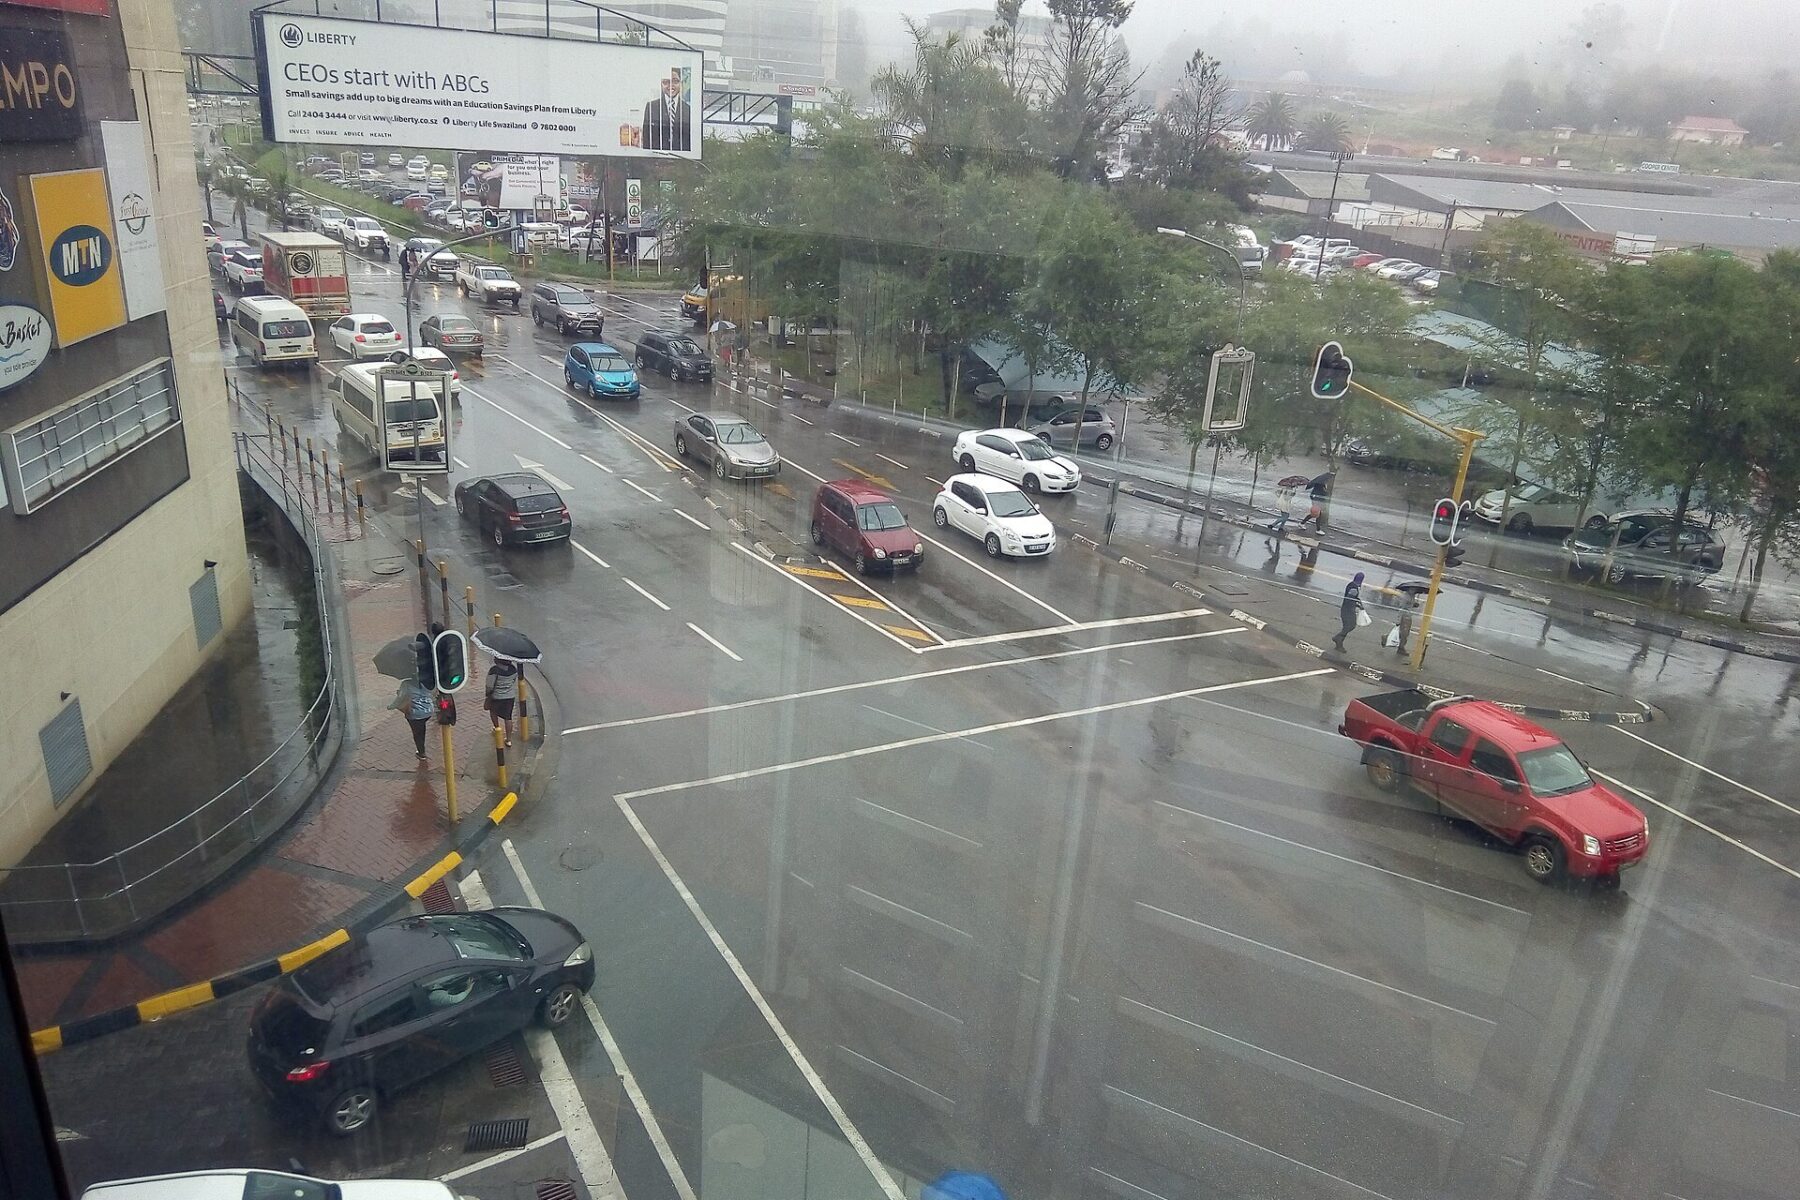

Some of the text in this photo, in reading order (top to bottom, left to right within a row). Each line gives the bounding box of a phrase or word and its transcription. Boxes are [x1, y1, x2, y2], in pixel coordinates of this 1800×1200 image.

[307, 32, 357, 46] LIBERTY
[0, 60, 76, 109] MPO
[284, 62, 490, 94] CEOs start with ABCs
[285, 89, 311, 99] Small
[311, 91, 345, 102] savings
[346, 93, 364, 101] add
[364, 95, 376, 103] up
[386, 95, 401, 105] big
[401, 96, 433, 106] dreams
[433, 98, 452, 107] with
[452, 100, 463, 108] an
[463, 100, 504, 110] Education
[504, 102, 533, 113] Savings
[534, 104, 551, 113] Plan
[551, 105, 570, 114] from
[570, 107, 597, 116] Liberty
[287, 110, 301, 118] Call
[302, 110, 324, 118] 2404
[325, 112, 347, 120] 3444
[357, 113, 372, 121] visit
[452, 118, 478, 129] Liberty
[478, 120, 492, 129] Life
[492, 121, 527, 130] Swaziland
[62, 236, 102, 276] MTN
[4, 316, 41, 349] Basket
